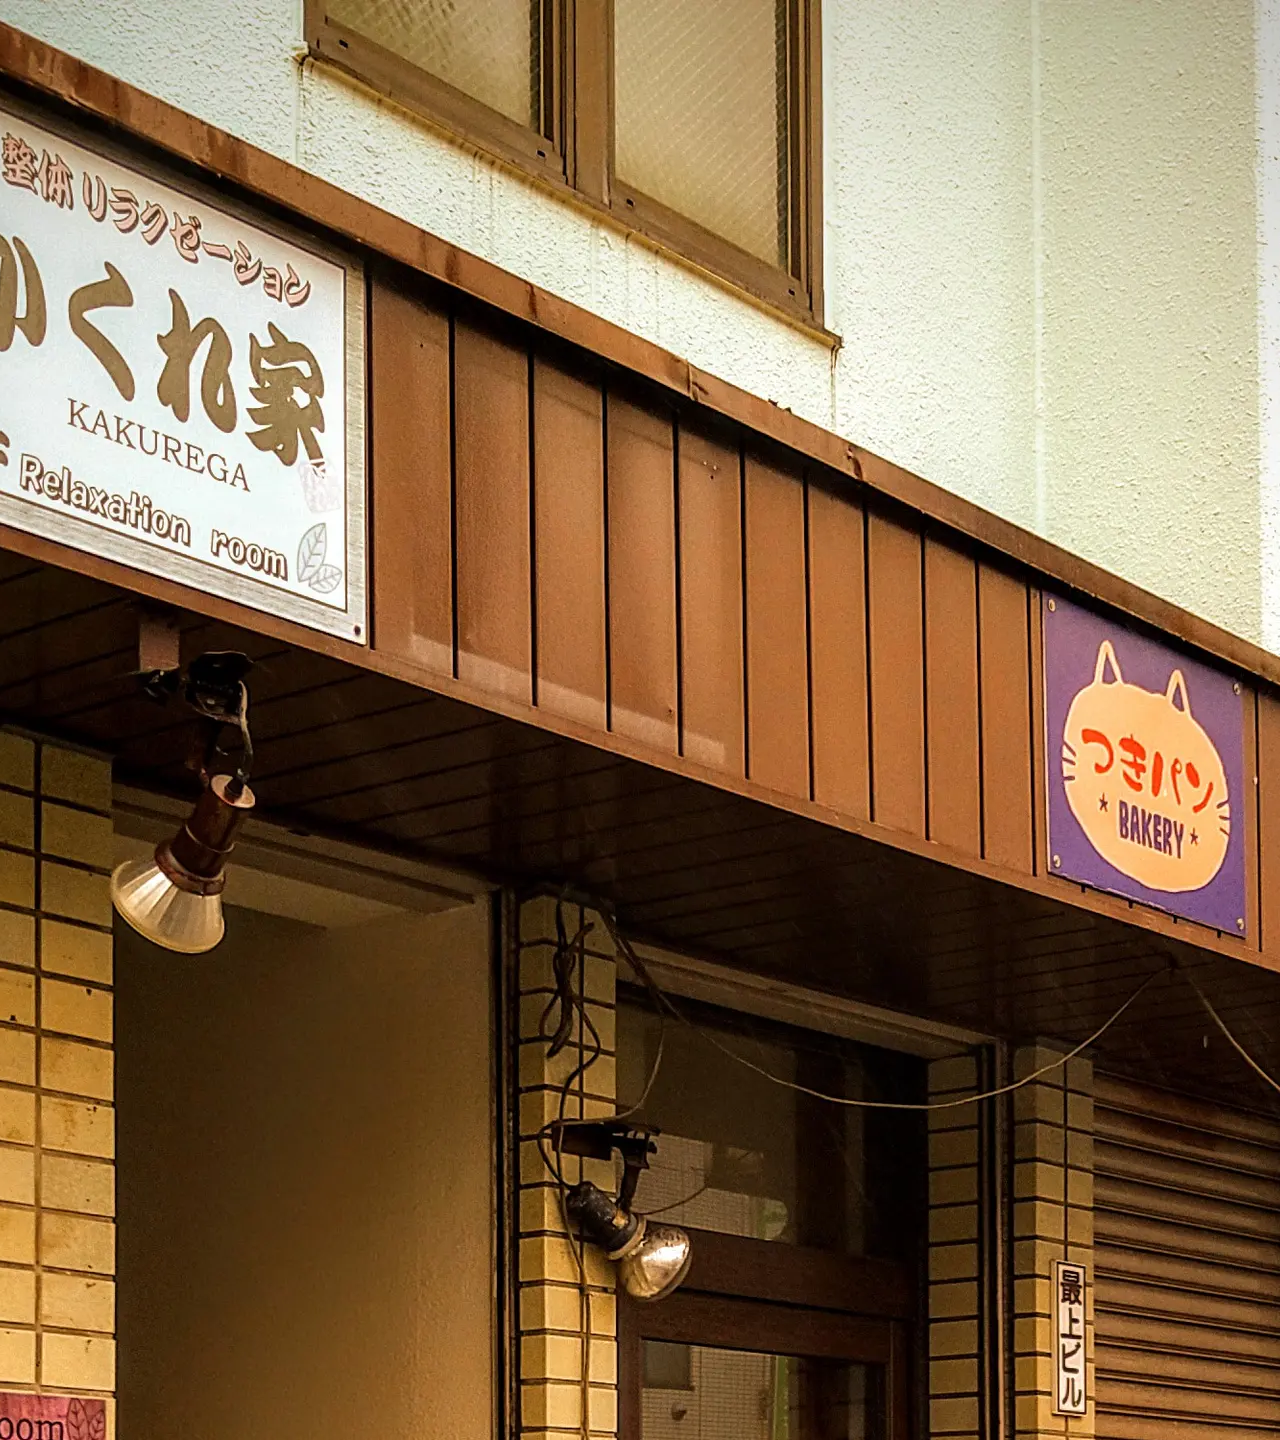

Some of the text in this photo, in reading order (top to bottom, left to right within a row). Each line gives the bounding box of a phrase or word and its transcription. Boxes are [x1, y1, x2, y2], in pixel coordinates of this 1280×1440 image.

[1, 131, 312, 308] 整体 リラクゼーション
[67, 397, 251, 492] KAKUREGA
[19, 454, 191, 547] Relaxation
[210, 528, 288, 581] room
[1081, 728, 1214, 813] つきパン
[1118, 799, 1184, 859] BAKERY
[1060, 1269, 1082, 1408] 最上ビル
